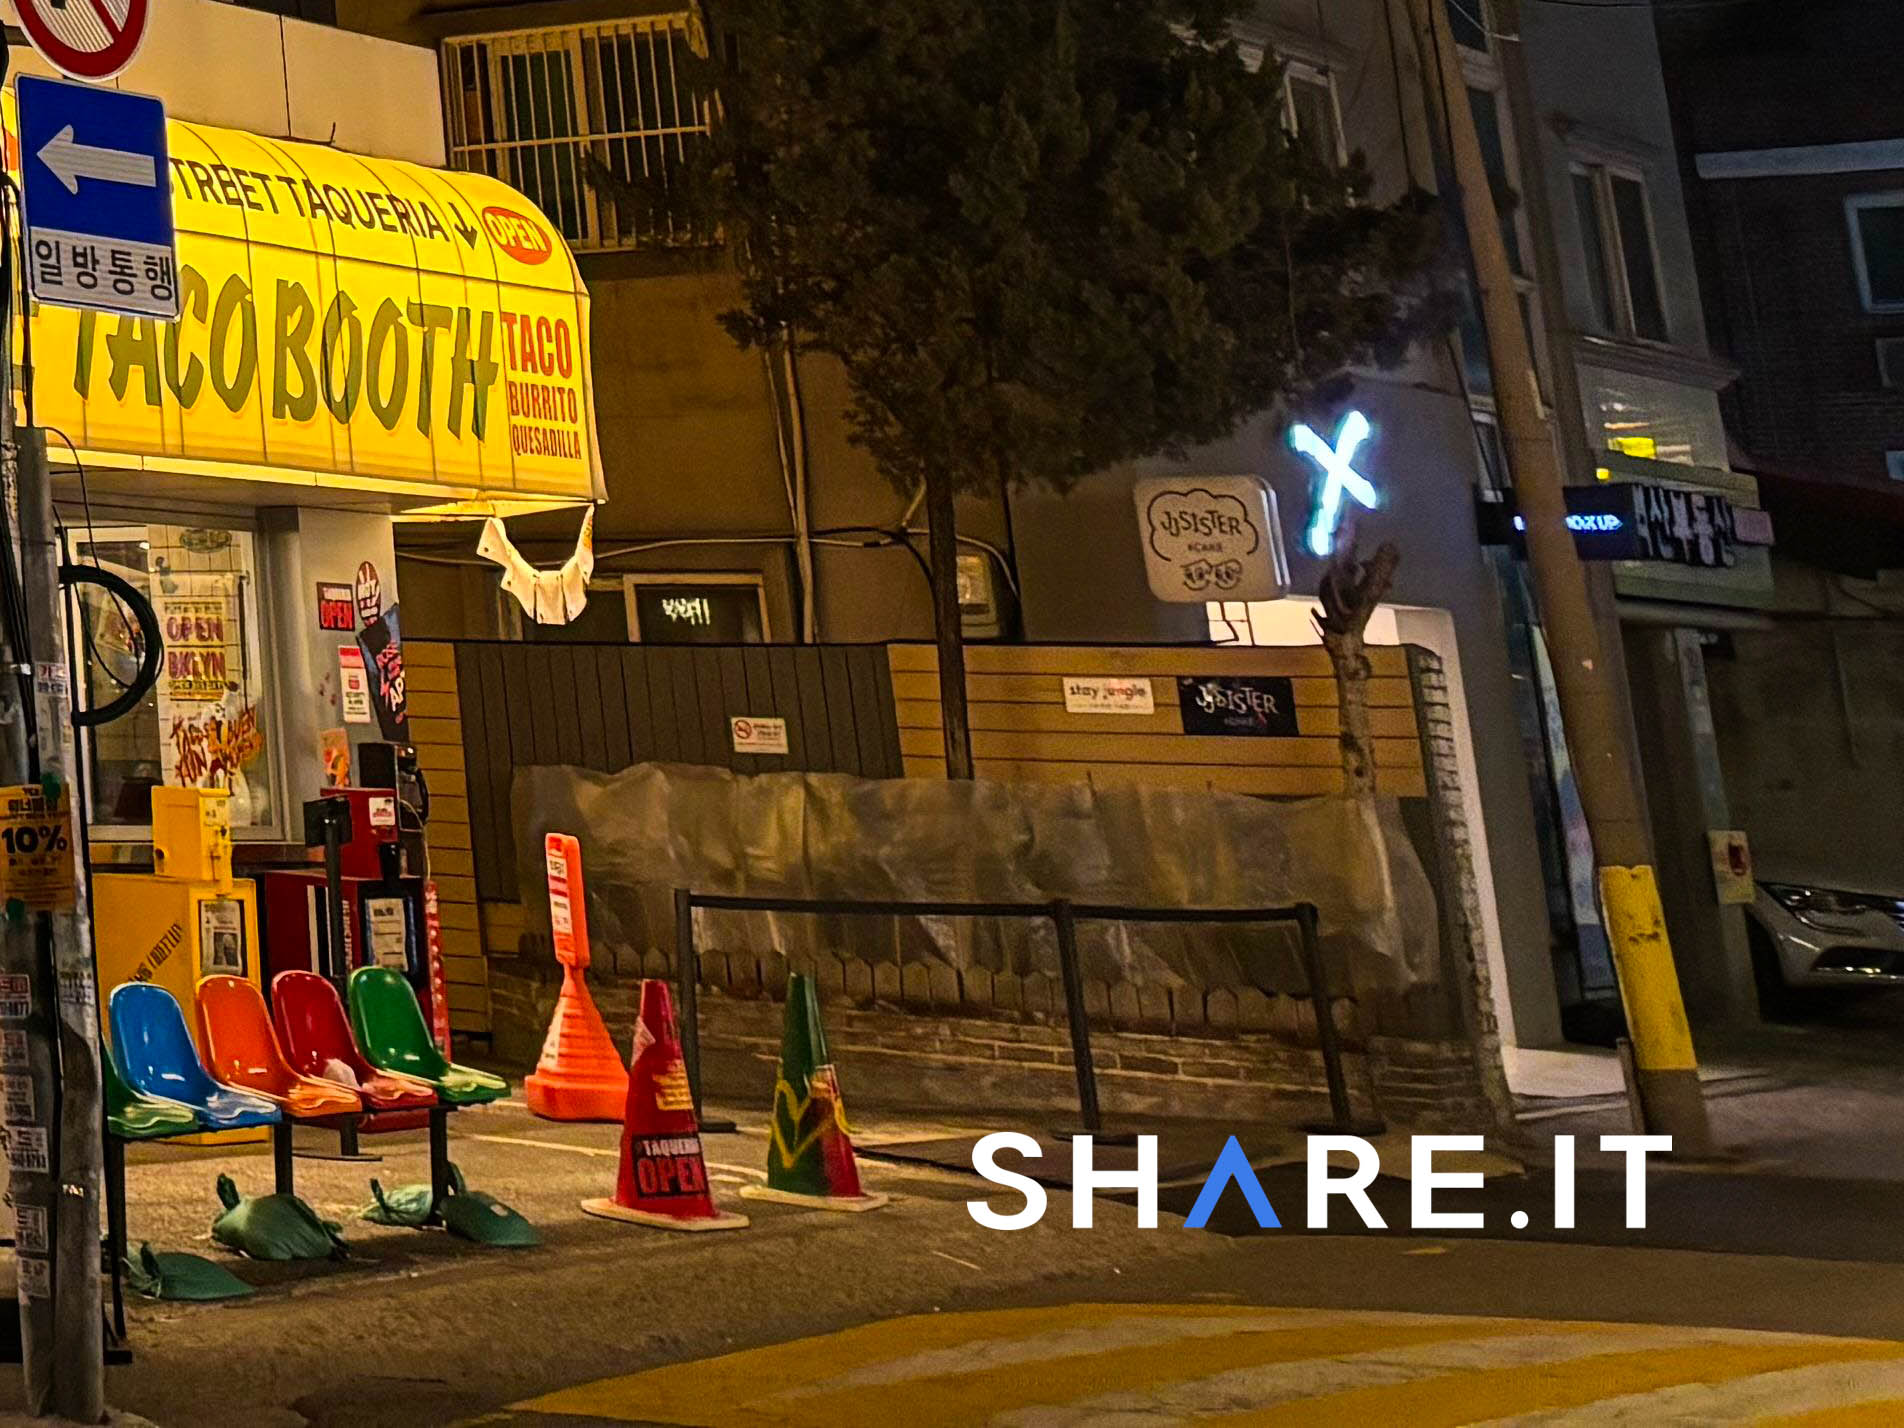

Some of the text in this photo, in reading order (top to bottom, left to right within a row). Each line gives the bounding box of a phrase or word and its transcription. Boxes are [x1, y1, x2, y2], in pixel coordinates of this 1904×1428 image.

[280, 176, 448, 243] TAQUERIA
[486, 209, 545, 255] OPEN
[33, 238, 175, 303] 일방통행
[272, 277, 501, 442] BOOTH
[501, 312, 573, 379] TACO
[506, 384, 578, 426] BURRITO
[512, 426, 581, 461] QUESADILLA
[166, 616, 224, 642] OPEN
[1, 824, 68, 855] 10%
